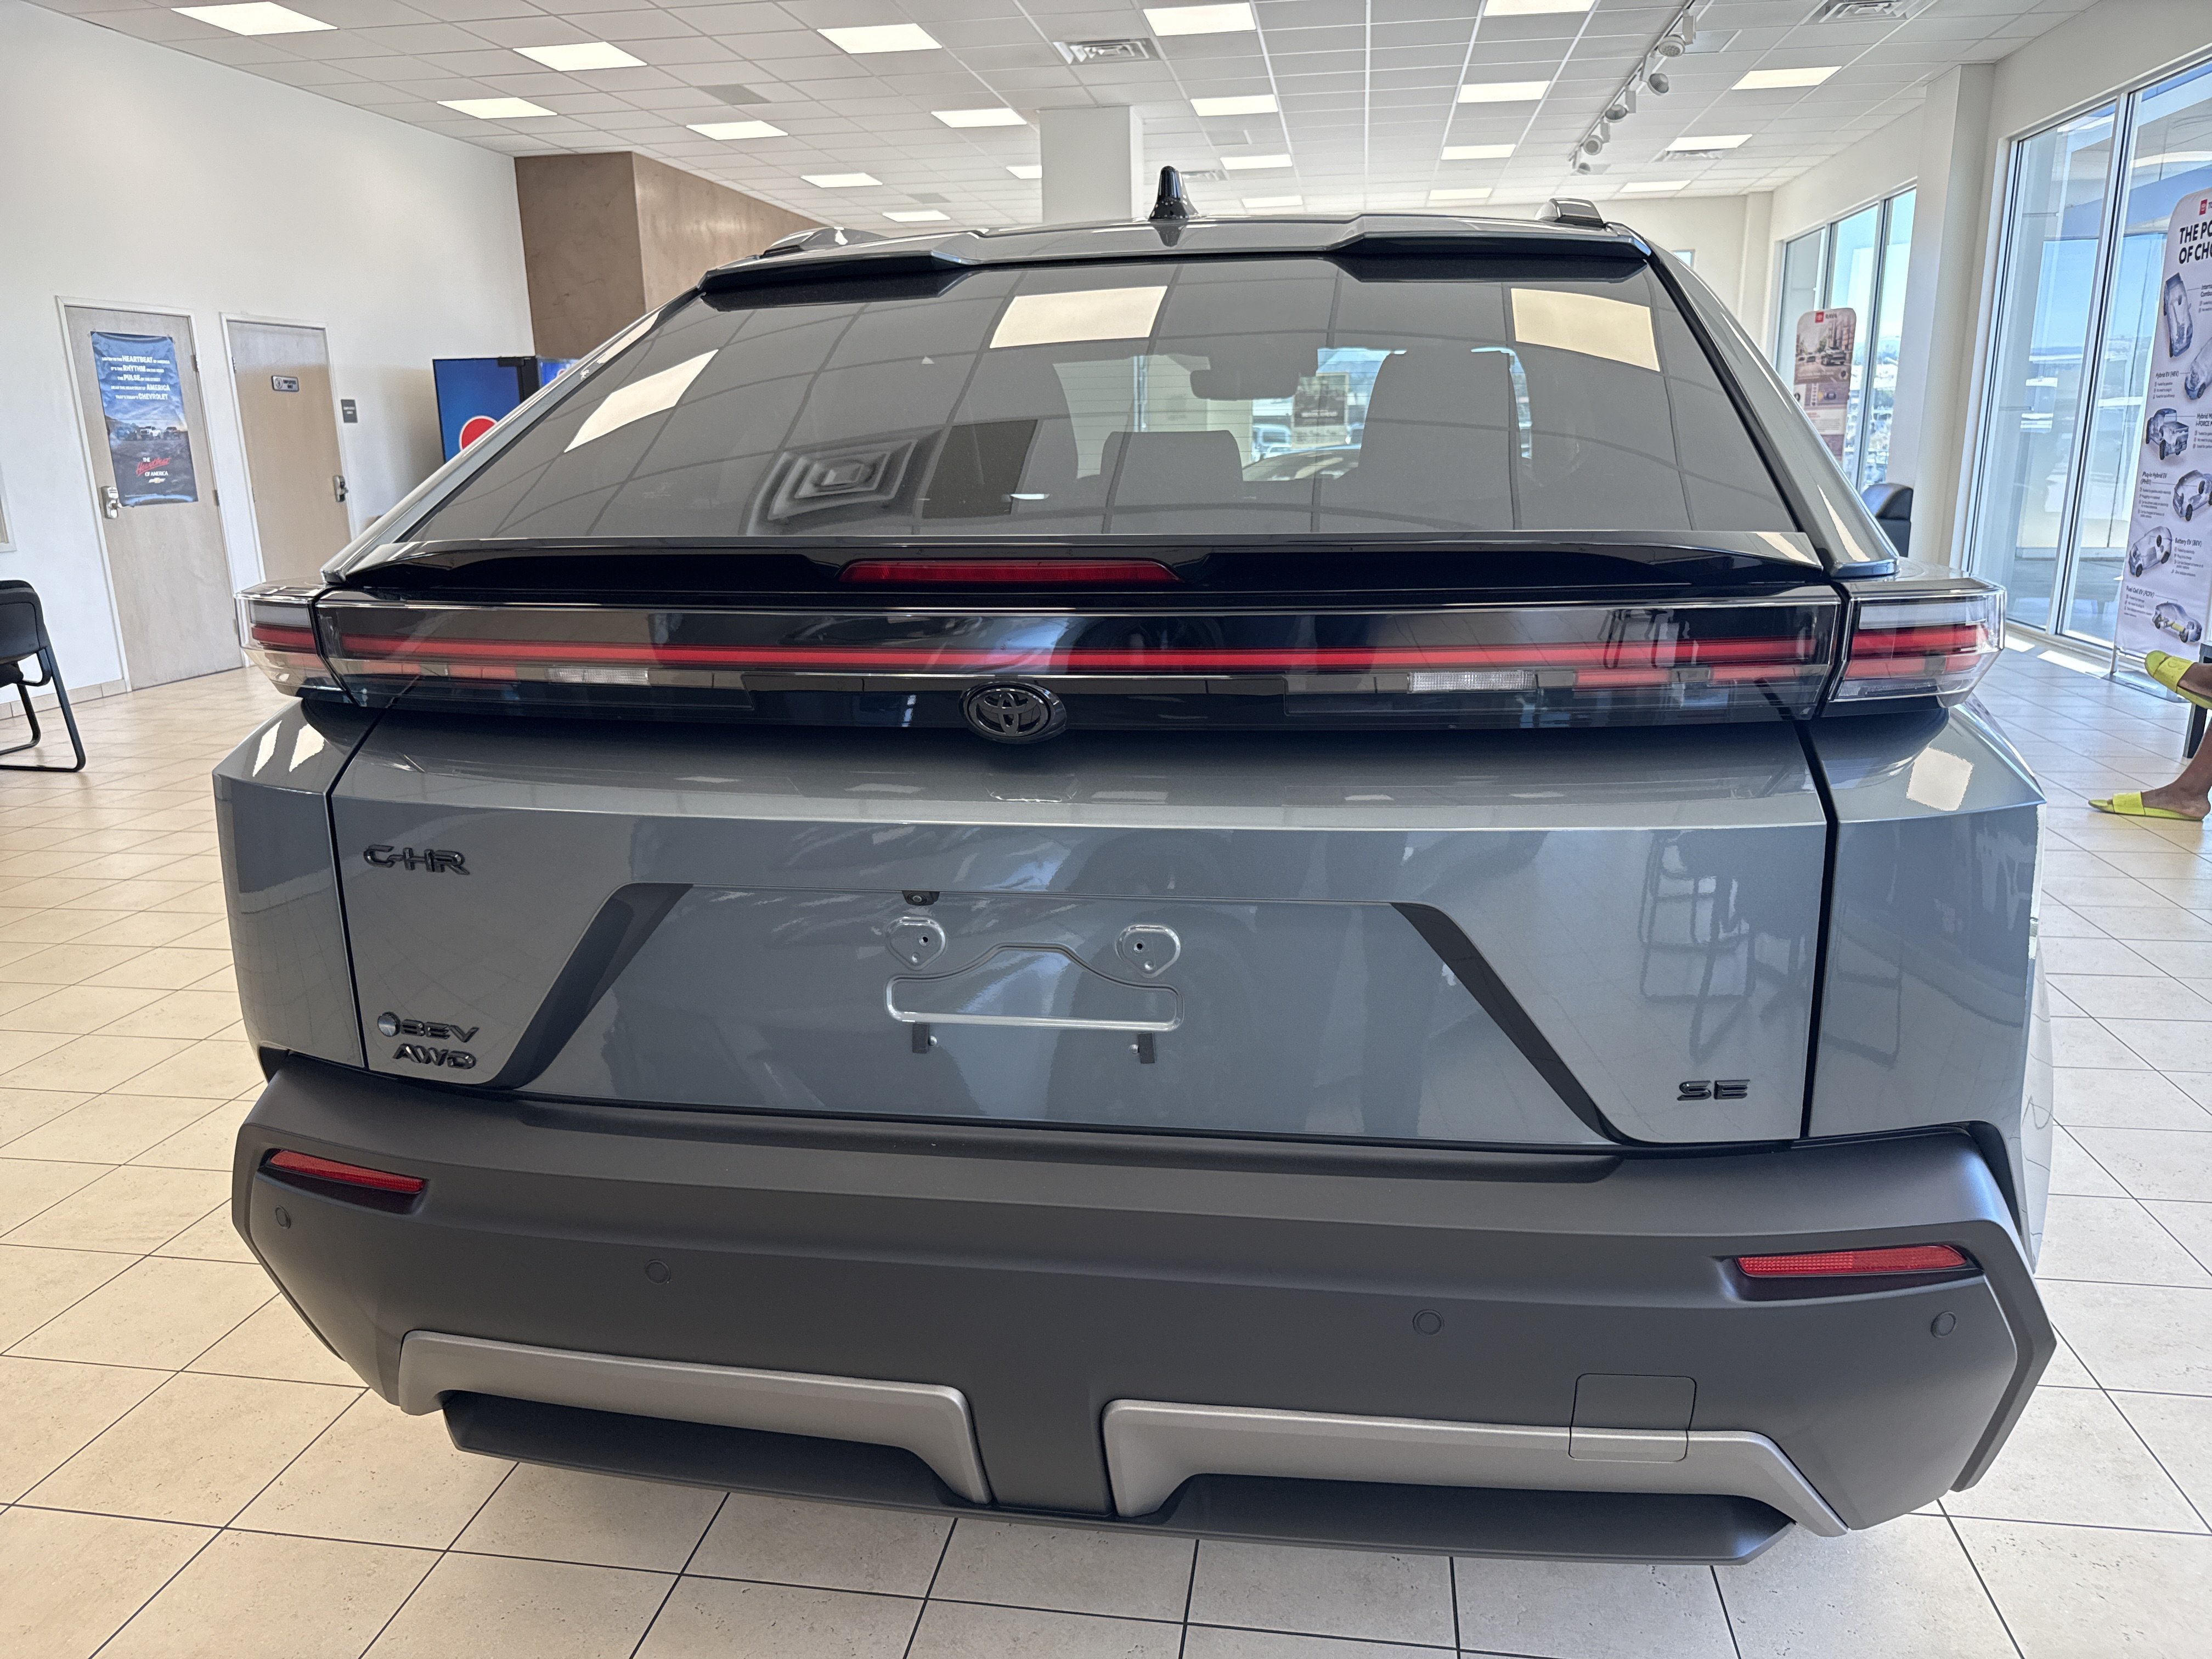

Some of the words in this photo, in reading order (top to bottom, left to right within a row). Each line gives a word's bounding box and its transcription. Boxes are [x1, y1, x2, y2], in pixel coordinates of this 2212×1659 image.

[2180, 223, 2199, 244] THE
[2179, 245, 2193, 264] OF
[122, 355, 153, 363] HEARTBEAT
[400, 1019, 479, 1043] BEV
[392, 1043, 477, 1070] AWD
[1677, 1079, 1751, 1101] SE
